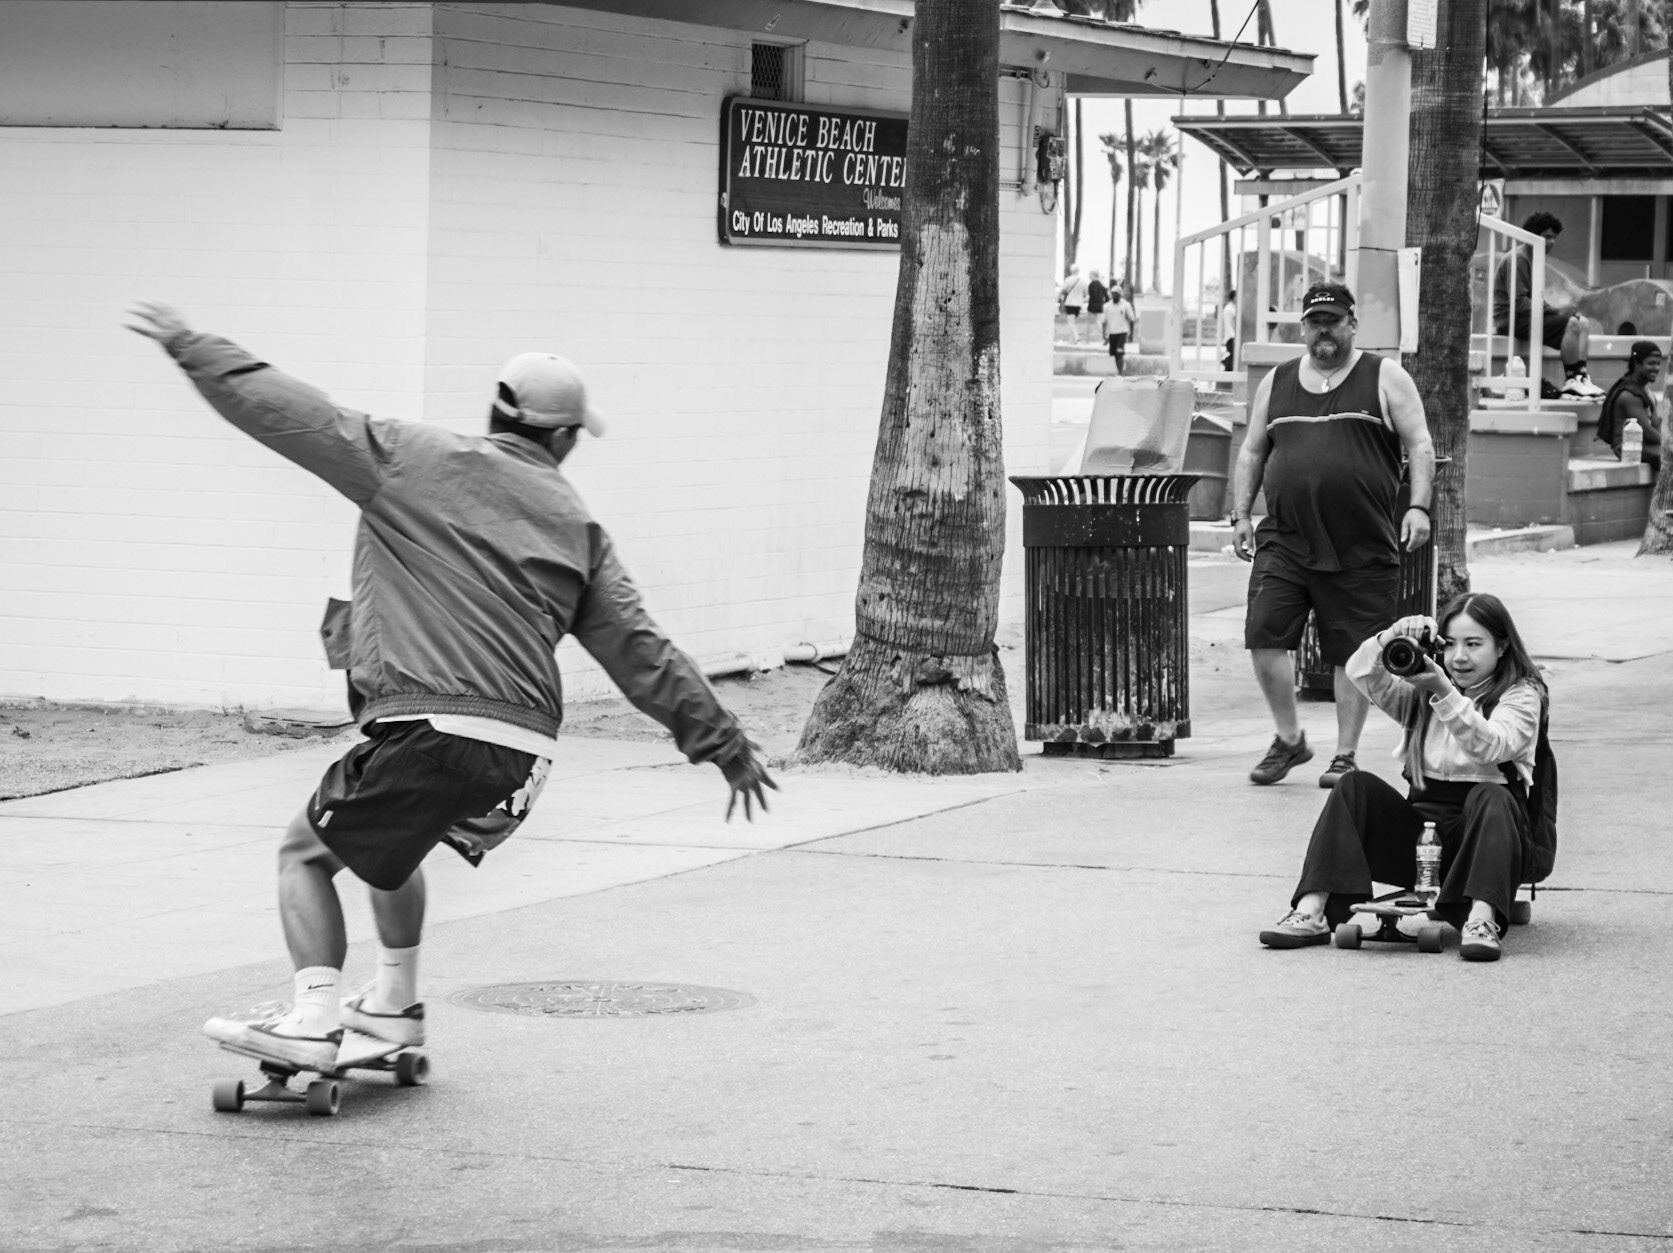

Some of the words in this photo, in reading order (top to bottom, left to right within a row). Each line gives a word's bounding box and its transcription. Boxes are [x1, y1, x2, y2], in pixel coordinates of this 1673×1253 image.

[741, 109, 809, 146] VENICE
[816, 116, 877, 152] BEACH
[738, 145, 835, 183] ATHLETIC
[732, 210, 750, 235] City
[753, 211, 764, 232] Of
[767, 212, 782, 233] Los
[786, 213, 819, 238] Angeles
[822, 215, 864, 236] Recreation
[867, 217, 874, 237] &
[877, 218, 898, 238] Parks
